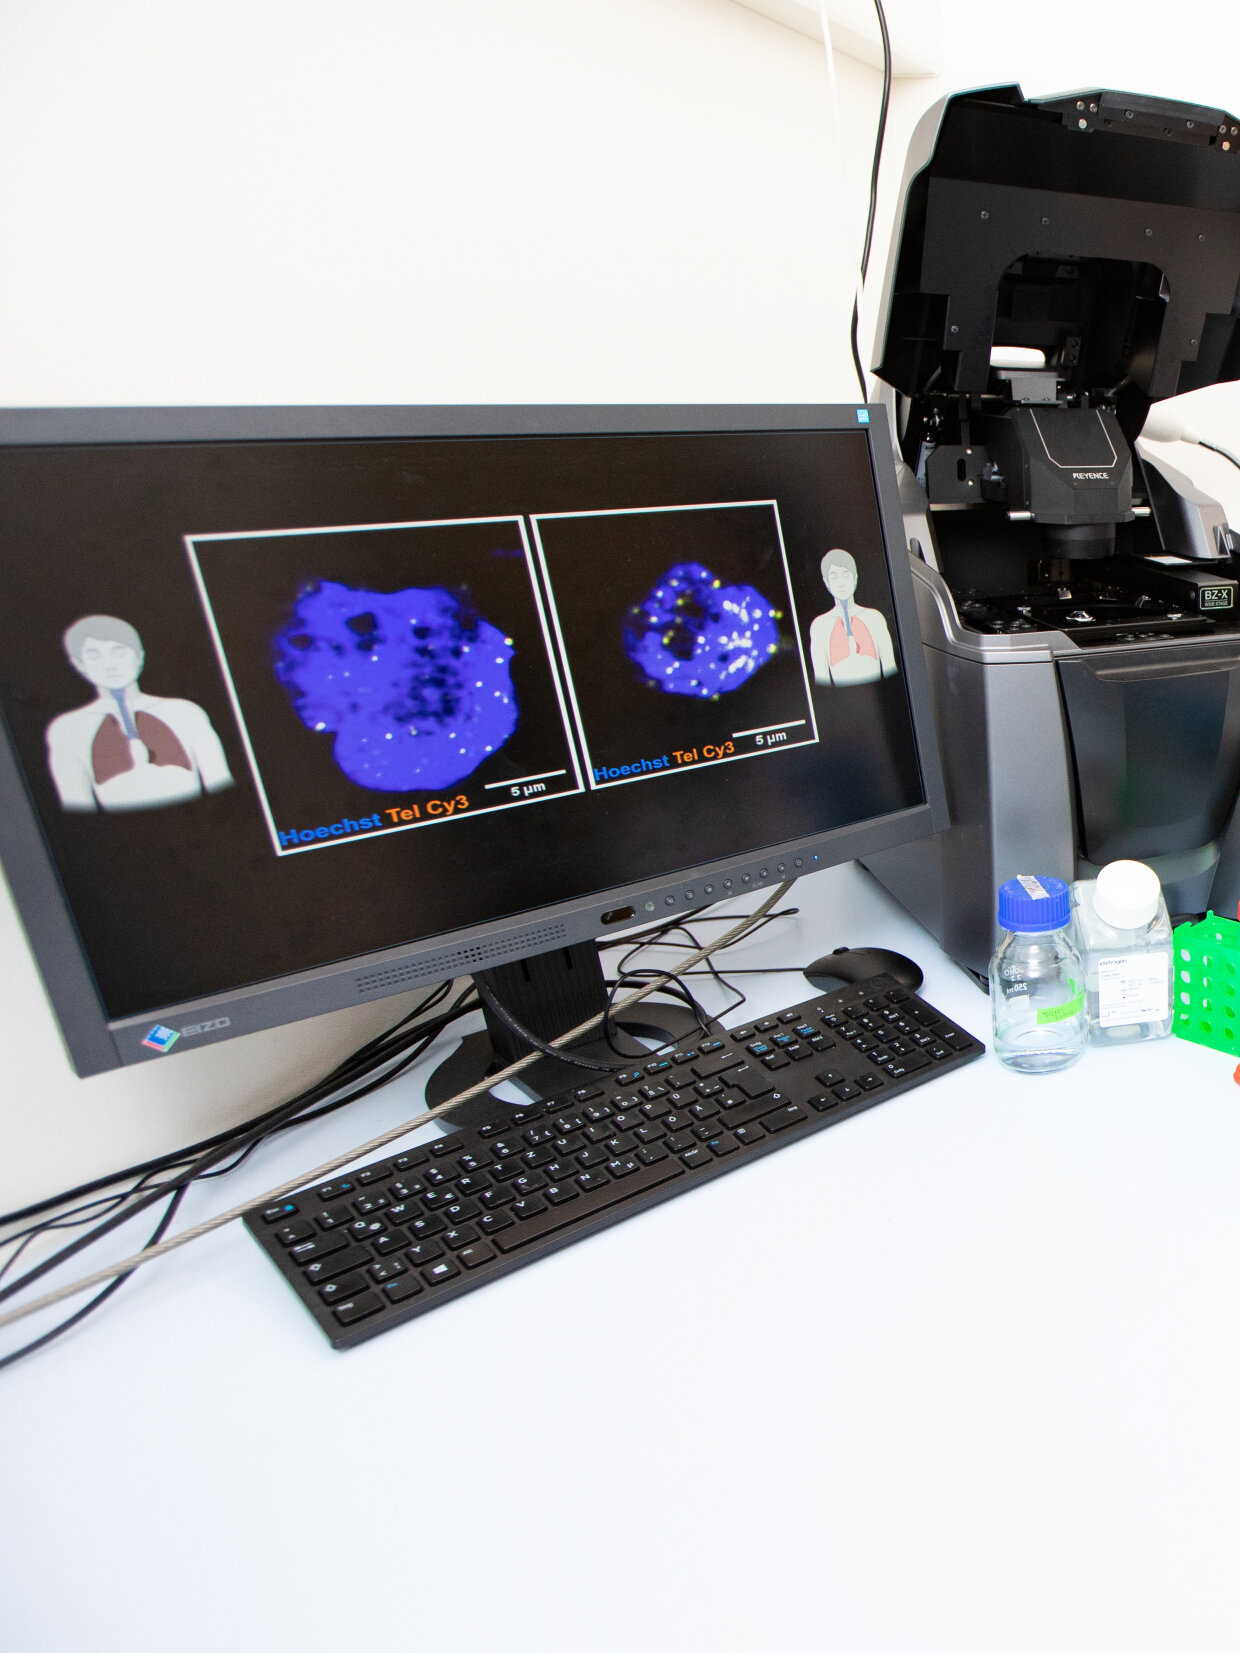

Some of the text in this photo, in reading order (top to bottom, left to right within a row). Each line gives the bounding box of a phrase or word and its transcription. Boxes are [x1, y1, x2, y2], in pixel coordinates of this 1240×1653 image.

[1072, 472, 1110, 480] KEYENCE
[1204, 590, 1229, 600] BZ-X
[755, 735, 764, 745] 5
[593, 741, 735, 781] Hoechst Tel Cy3
[510, 786, 521, 797] 5
[279, 794, 470, 847] Hoechst Tel Cy3
